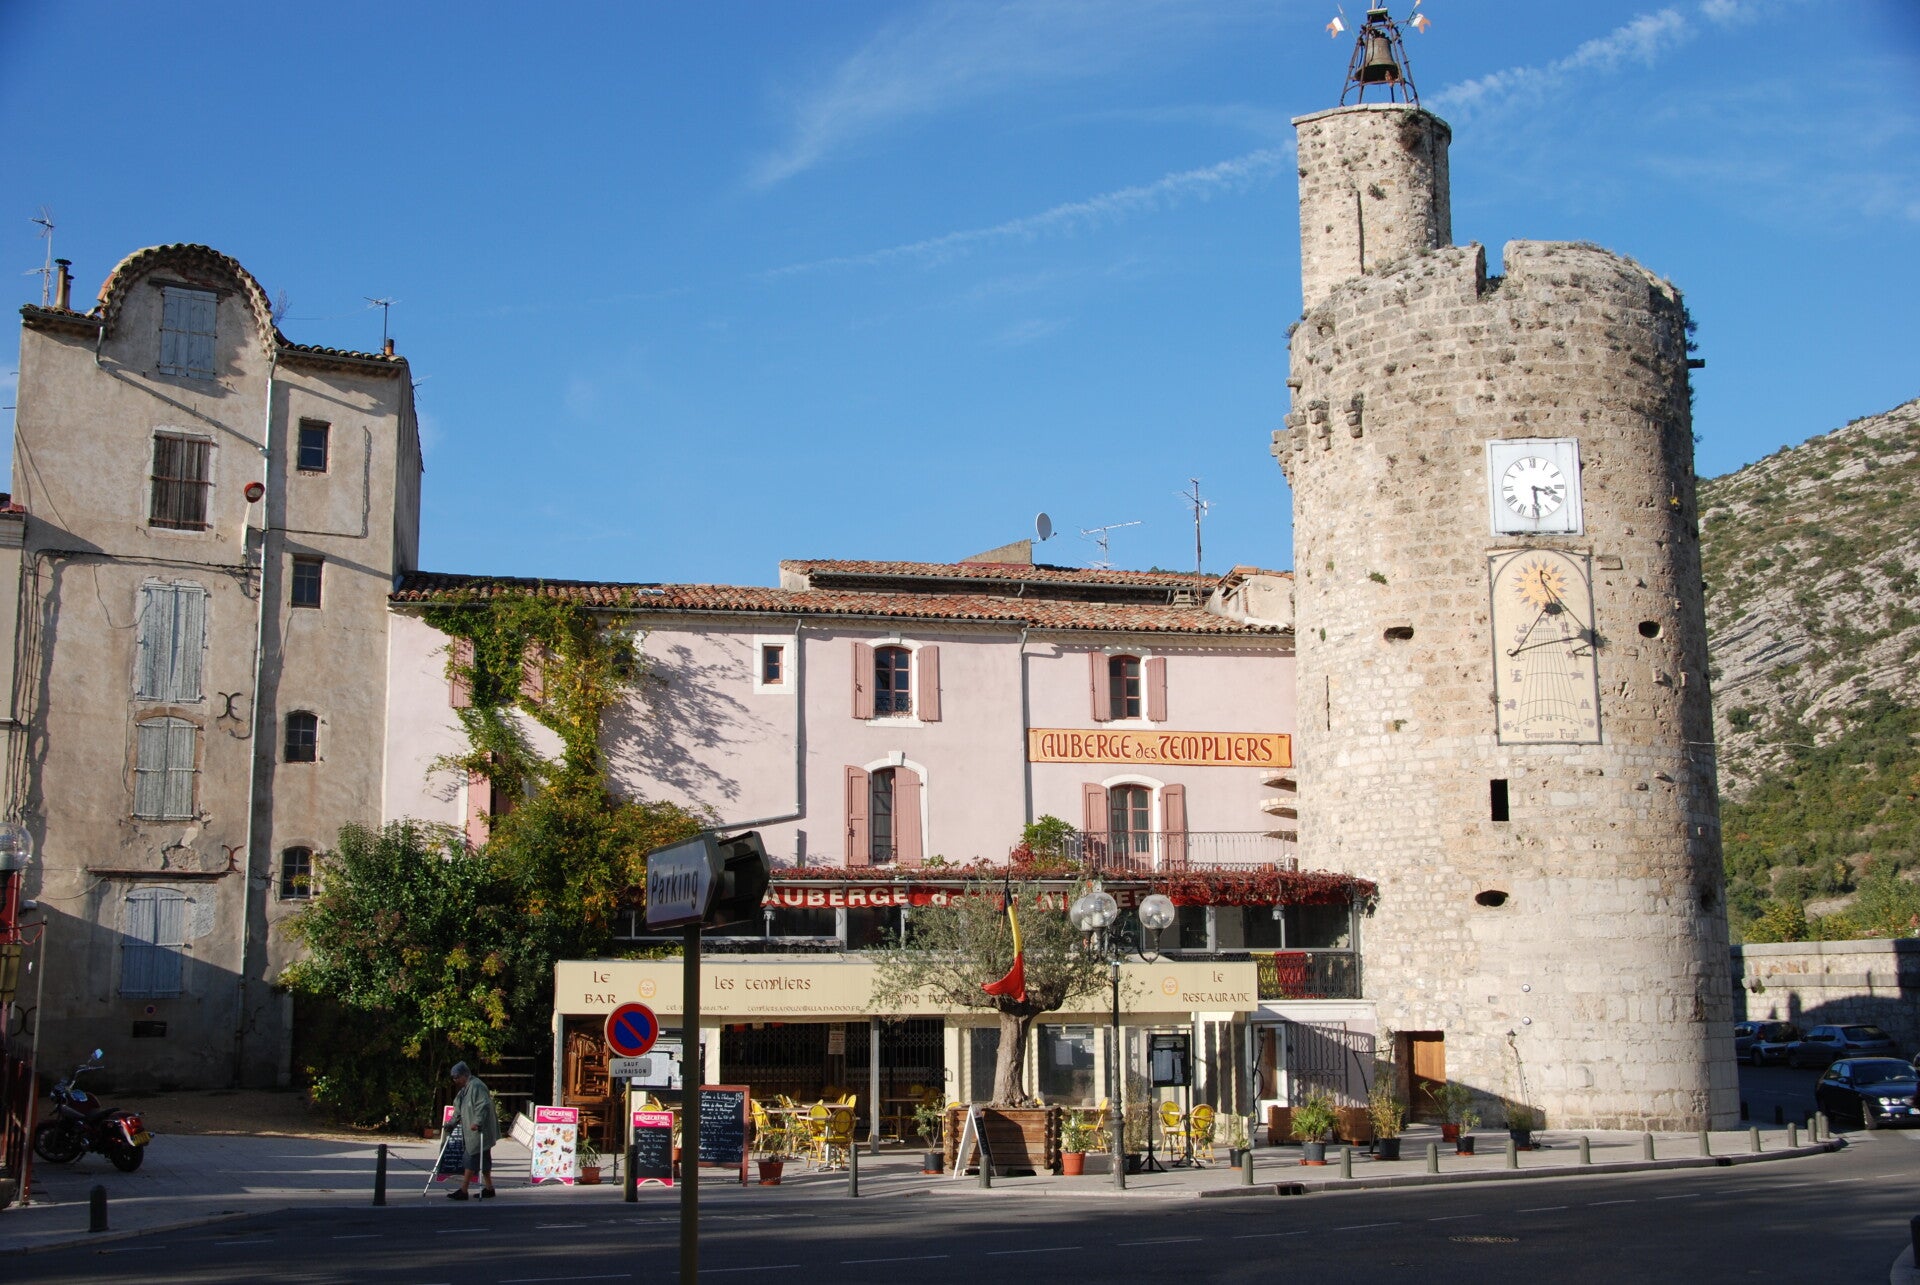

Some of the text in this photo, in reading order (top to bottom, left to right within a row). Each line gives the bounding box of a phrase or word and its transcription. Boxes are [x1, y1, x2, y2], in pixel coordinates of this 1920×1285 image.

[1041, 733, 1273, 762] AUBERGE des TEMPLIERS
[651, 864, 699, 911] Parking
[761, 887, 909, 906] AUBERGE
[593, 971, 611, 983] LE
[1213, 970, 1224, 982] LE
[714, 976, 811, 991] LES TEMPLIERS
[585, 993, 616, 1004] BAR
[1182, 993, 1250, 1003] RESTAURANT
